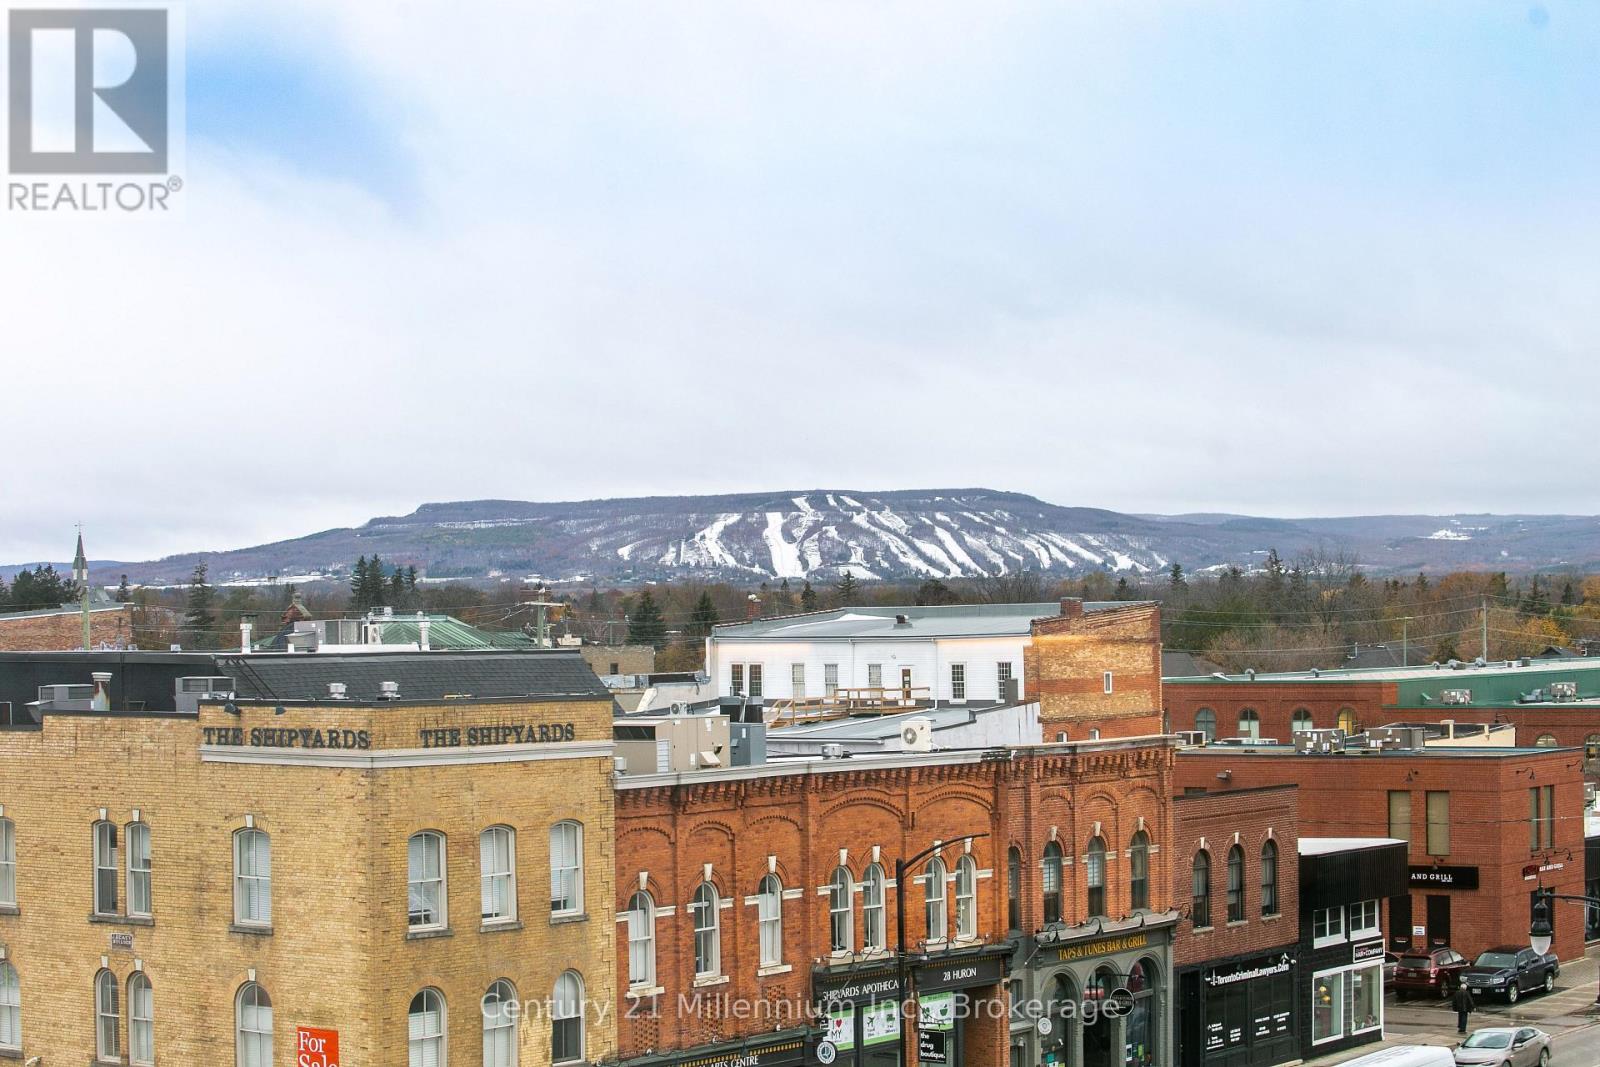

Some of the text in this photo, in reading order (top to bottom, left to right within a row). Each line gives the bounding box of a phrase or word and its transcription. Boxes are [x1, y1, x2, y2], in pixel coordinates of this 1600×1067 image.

[203, 727, 371, 749] THE SHIPYARDS
[419, 723, 575, 748] THE SHIPYARDS
[1059, 934, 1148, 960] TAPS & TUNES BAR & GRILL
[952, 967, 977, 980] HURON
[822, 978, 908, 1002] SHIPYARDS APOTHECA
[831, 1030, 842, 1039] MY
[920, 1032, 930, 1040] the
[299, 1031, 326, 1053] For
[920, 1041, 934, 1050] drug
[299, 1053, 338, 1067] Sl
[731, 1055, 759, 1067] CENTRE
